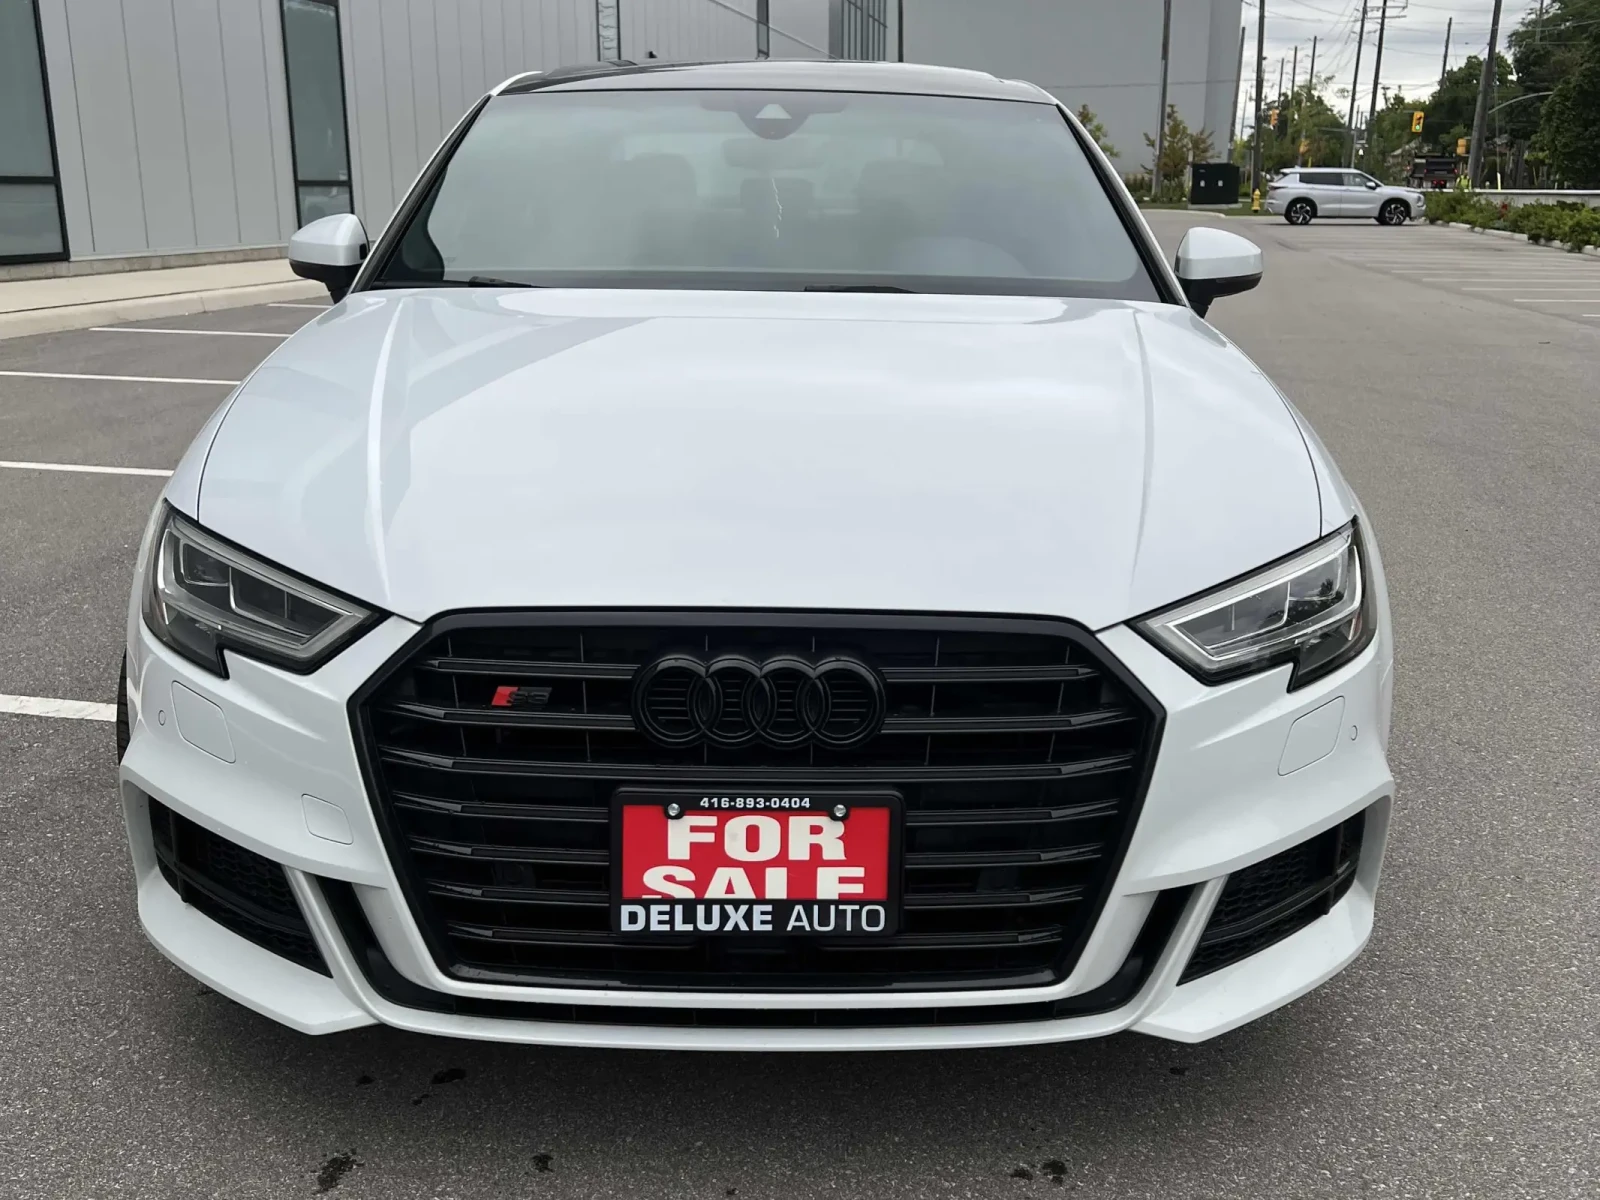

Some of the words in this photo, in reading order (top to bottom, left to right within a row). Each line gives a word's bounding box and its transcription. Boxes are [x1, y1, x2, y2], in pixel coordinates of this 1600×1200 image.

[700, 797, 811, 809] 416-893-0404
[667, 815, 847, 862] FOR
[620, 904, 773, 931] DELUXE
[786, 904, 886, 932] AUTO
